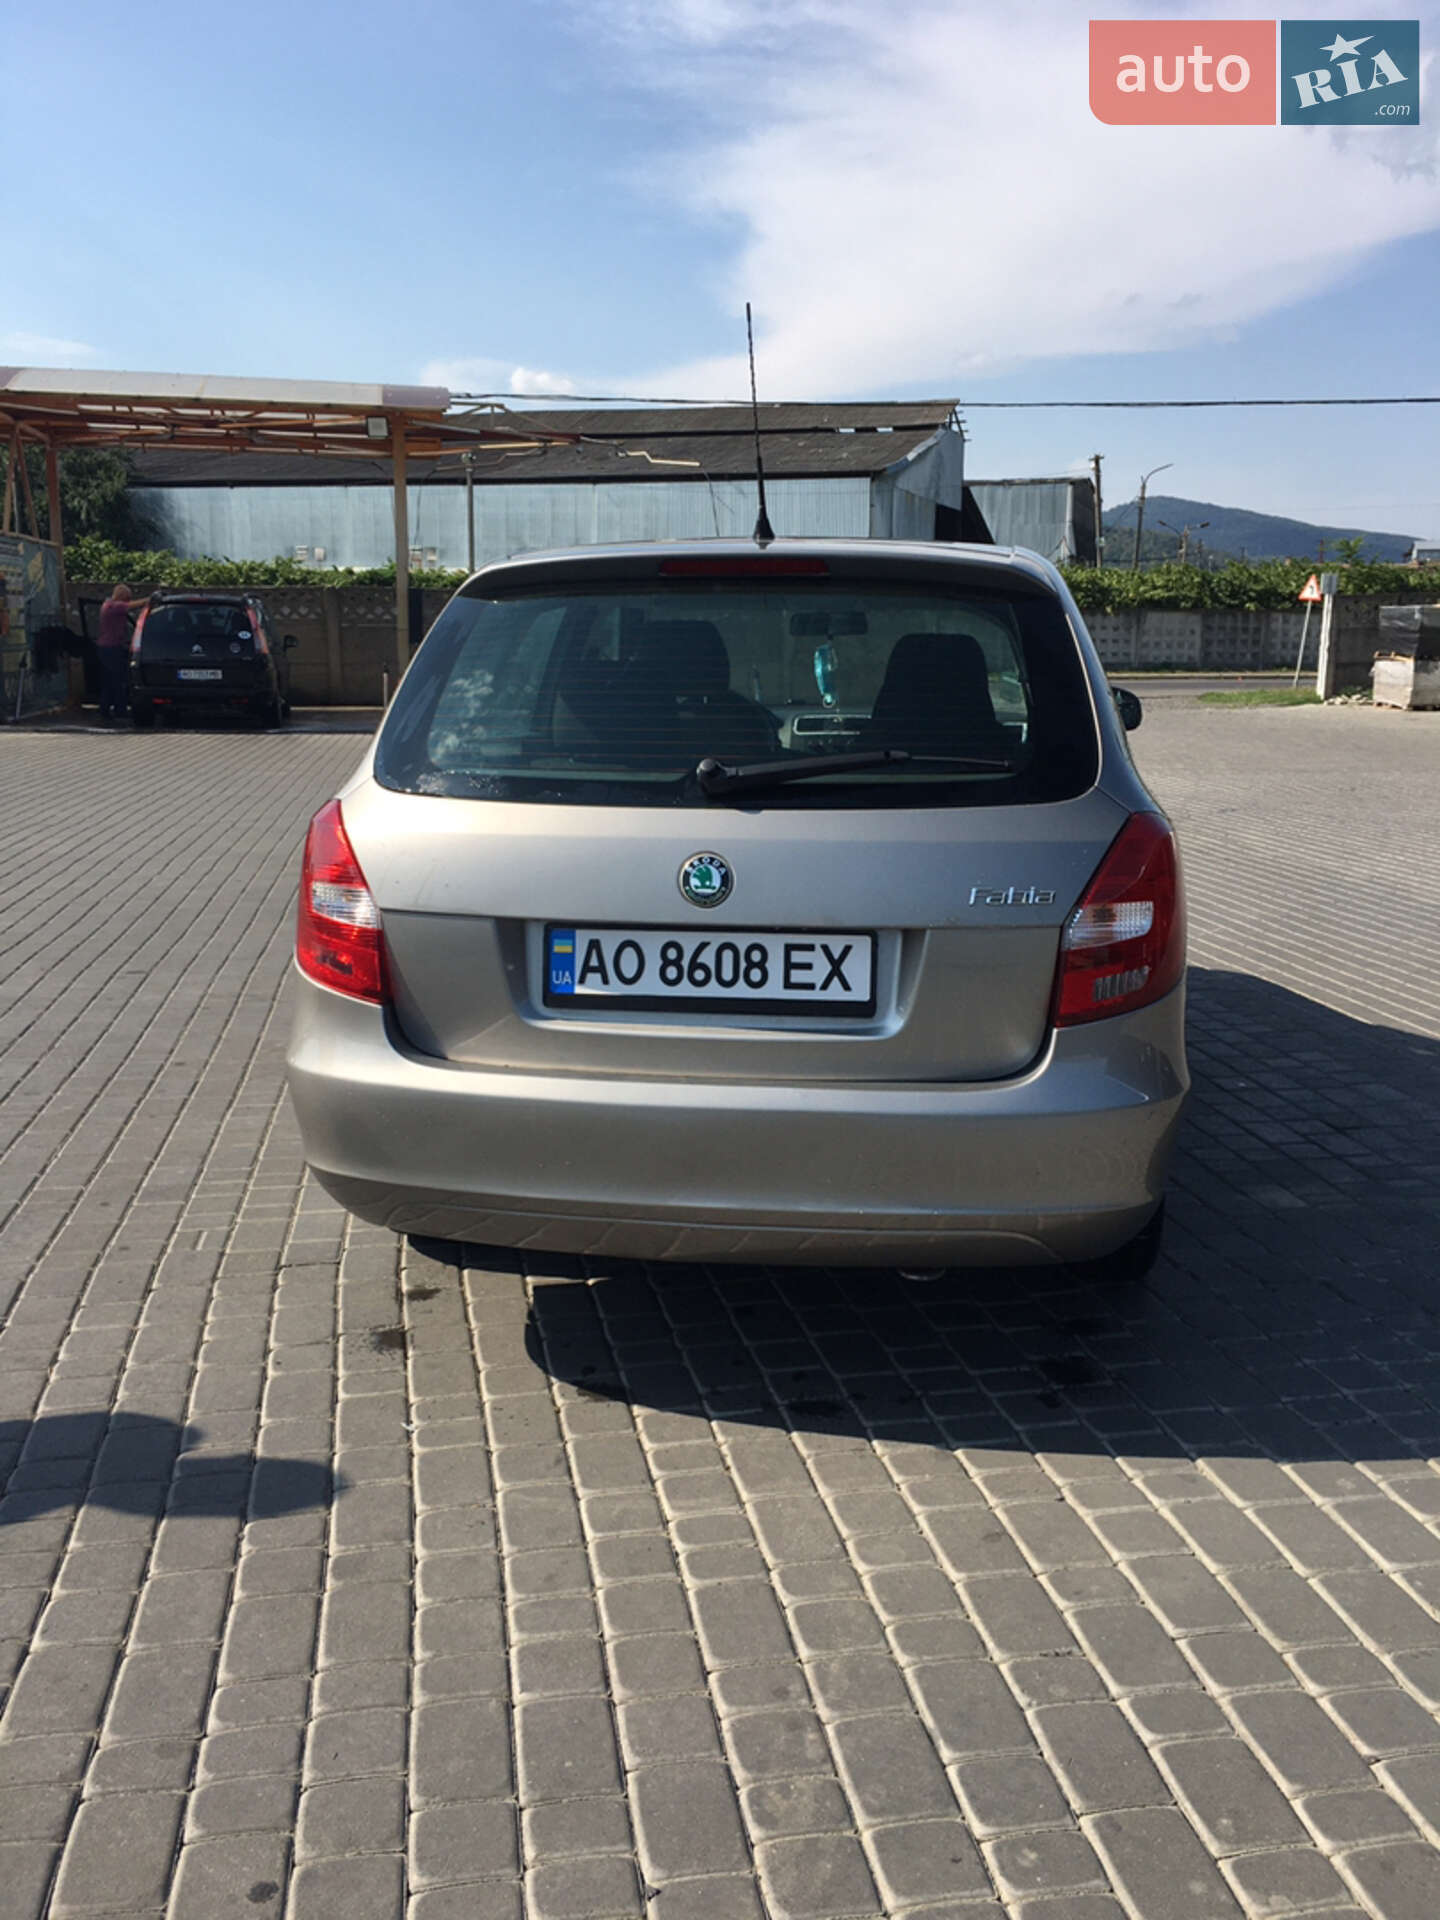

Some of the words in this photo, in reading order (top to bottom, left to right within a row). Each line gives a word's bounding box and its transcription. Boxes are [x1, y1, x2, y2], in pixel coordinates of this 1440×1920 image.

[552, 971, 572, 984] UA
[578, 938, 646, 986] AO
[658, 940, 769, 988] 8608
[783, 943, 853, 992] EX
